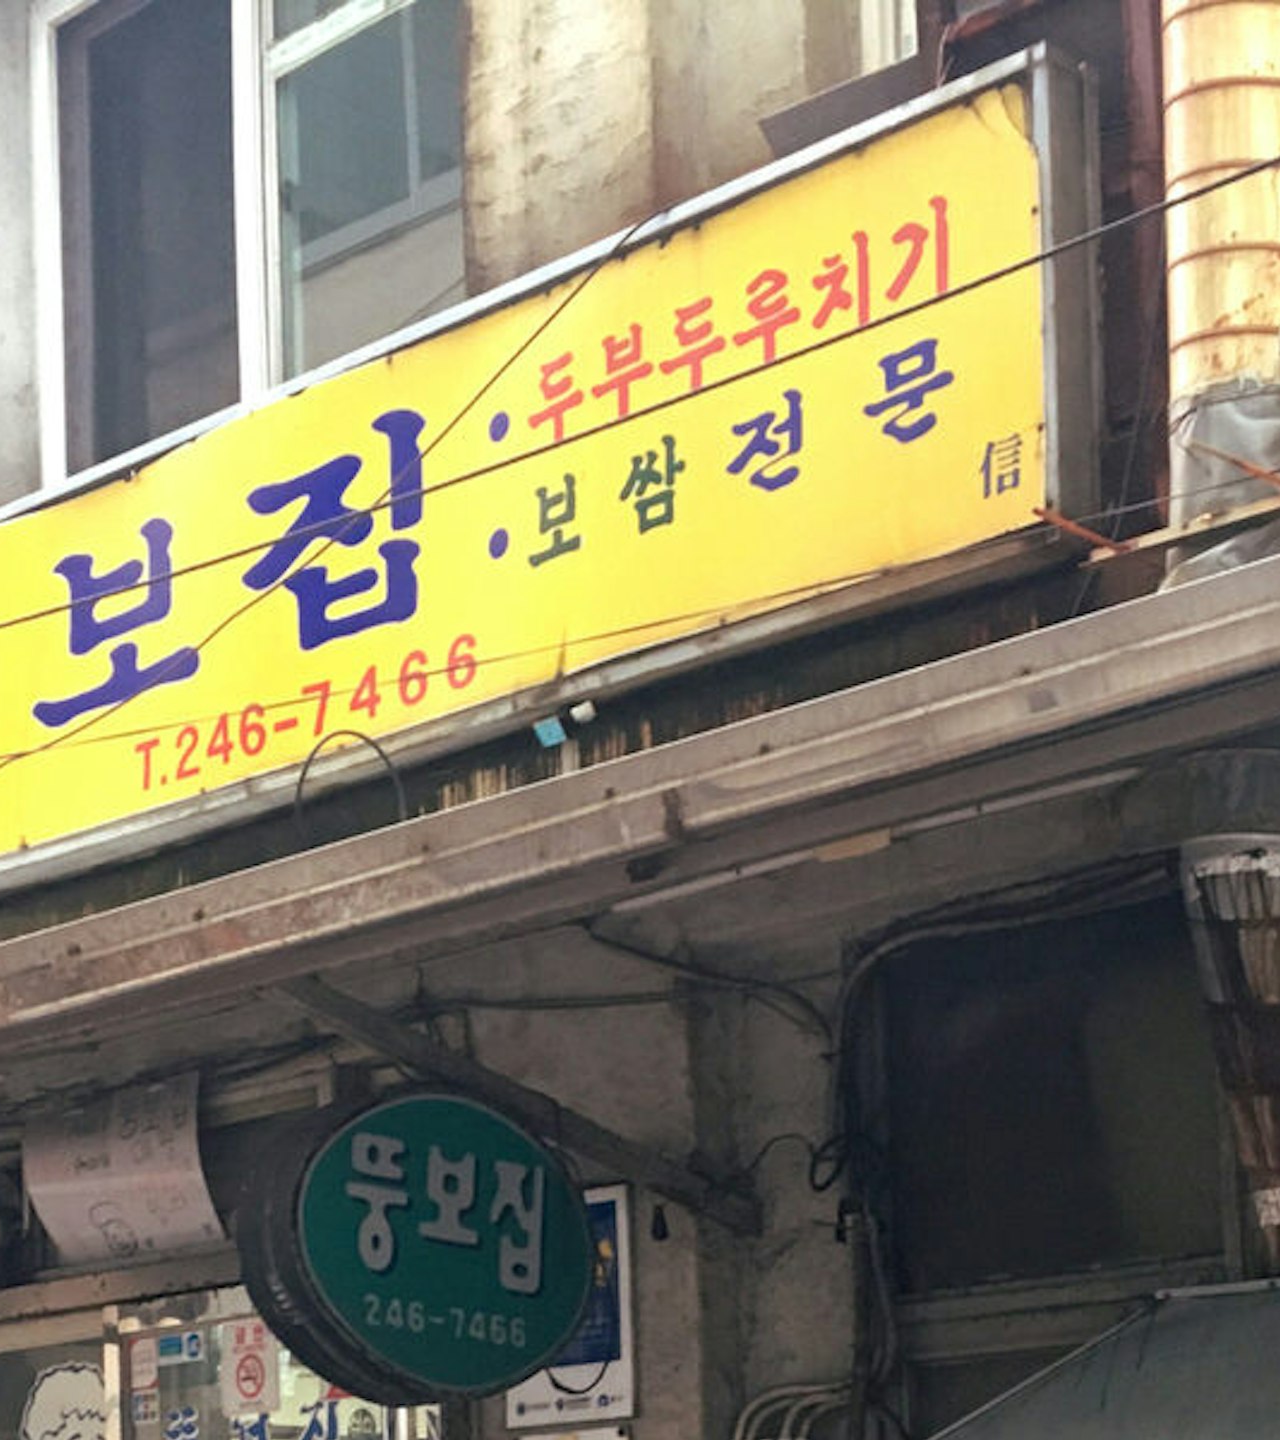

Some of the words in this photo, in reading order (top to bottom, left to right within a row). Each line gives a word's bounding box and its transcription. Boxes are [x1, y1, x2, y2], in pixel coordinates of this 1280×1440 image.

[526, 196, 954, 447] 두부두루치기
[526, 337, 956, 569] 보쌈전문
[135, 633, 478, 793] T.246-7466
[346, 1132, 545, 1294] 뚱보집
[363, 1293, 527, 1348] 246-7466
